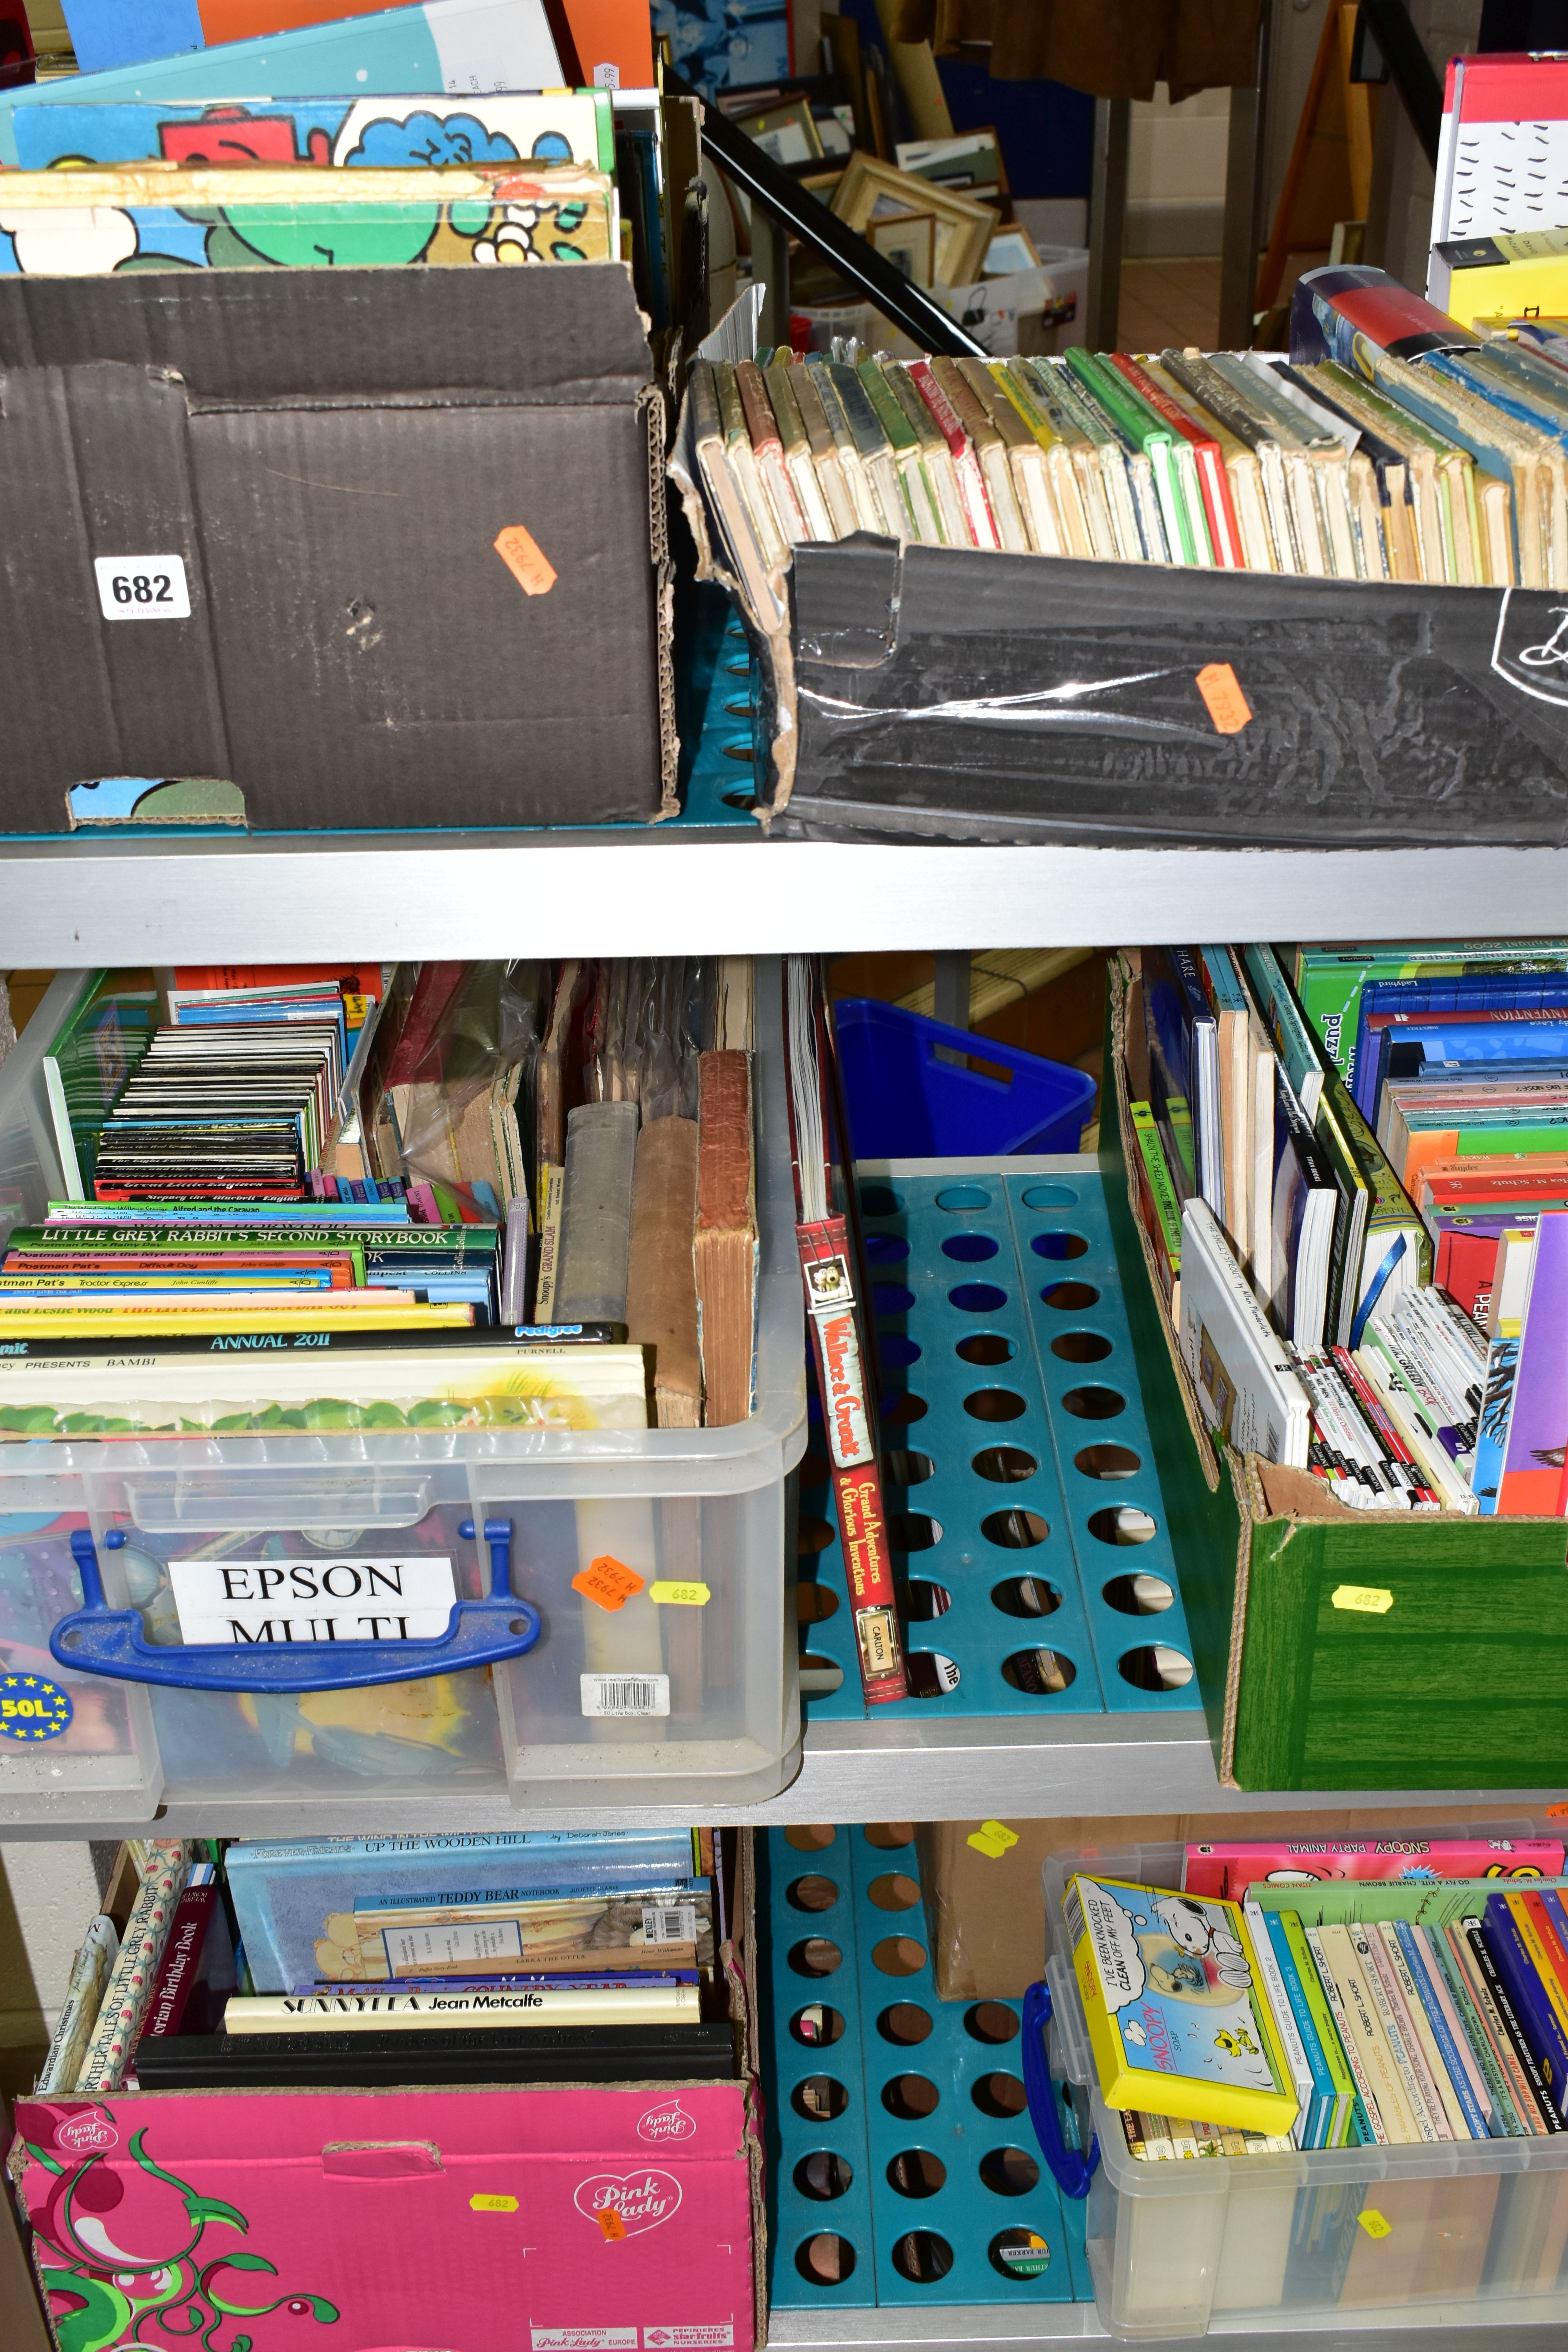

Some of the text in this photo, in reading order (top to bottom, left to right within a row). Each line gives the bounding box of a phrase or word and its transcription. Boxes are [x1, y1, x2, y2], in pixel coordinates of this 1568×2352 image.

[505, 537, 544, 586] H 7932
[113, 575, 174, 603] 682
[1203, 673, 1238, 730] H 7932
[1176, 949, 1196, 978] HARE
[1144, 1133, 1170, 1200] SHAUN THE SHEEP MOVIE:
[1306, 1156, 1321, 1182] TITAN BOOKS
[42, 1229, 451, 1245] LITTLE GREY RABBIT'S SECOND STORYBOOK
[1207, 1221, 1218, 1234] THE
[456, 1229, 467, 1250] Collins
[1212, 1234, 1229, 1256] SHELLY
[536, 1225, 556, 1305] Snoopy's GRAND SLAM
[1223, 1256, 1241, 1279] SPROUT
[113, 1279, 149, 1288] Express
[1241, 1290, 1252, 1305] Allan
[1249, 1306, 1271, 1338] Plenderleith
[211, 1334, 288, 1350] ANNUAL
[294, 1333, 330, 1347] 2011
[515, 1324, 583, 1338] Pedigree
[25, 1360, 91, 1368] PRESENTS
[107, 1358, 156, 1367] BAMBI
[823, 1314, 861, 1458] Wallace & Gromit
[1336, 1452, 1352, 1474] EGMONT
[1382, 1462, 1399, 1485] EGMONT
[1365, 1467, 1382, 1490] EGMONT
[840, 1477, 866, 1596] & Glorious Inventions
[859, 1482, 881, 1584] Grand Adventures
[216, 1565, 405, 1600] EPSON
[597, 1563, 636, 1591] H 7932
[588, 1577, 628, 1603] H 7932
[672, 1589, 697, 1600] 682
[1354, 1593, 1380, 1607] 682
[872, 1626, 884, 1661] CARLTON
[1, 1699, 53, 1719] 50L
[365, 1834, 532, 1853] UP THE WOODEN HILL
[550, 1833, 561, 1842] by
[994, 1829, 1011, 1843] 682
[1285, 1840, 1430, 1855] SNOOPY PARTY ANIMAL
[390, 1896, 436, 1905] ILLUSTRATED
[438, 1891, 482, 1905] TEDDY
[485, 1889, 519, 1902] BEAR
[521, 1888, 560, 1896] NOTEBOOK
[1088, 1899, 1118, 1987] I'VE BEEN KNOCKED
[1099, 1900, 1131, 1991] CLEAN OFF MY FEET
[97, 1886, 159, 2052] TALES OF LITTLE GREY RABBIT
[150, 1922, 198, 2036] orian Birthday Book
[1268, 1963, 1278, 1981] BOOK
[1273, 1983, 1283, 1998] LIFE
[1287, 1973, 1299, 1992] BOOK
[281, 1994, 543, 2014] SUNNYLEA Jean Metcalfe
[1278, 1998, 1286, 2008] TO
[1293, 1993, 1304, 2008] LIFE
[1281, 2010, 1293, 2031] GUIDE
[1298, 2008, 1307, 2018] TO
[1140, 2001, 1174, 2071] SNOOPY
[1170, 2031, 1181, 2051] SOAP
[1302, 2019, 1314, 2041] GUIDE
[39, 1999, 74, 2091] Edwardian Christmas
[1288, 2032, 1303, 2065] PEANUTS
[1309, 2042, 1325, 2076] PEANUTS
[1335, 2011, 1382, 2131] GOSPEL ACCORDING TO PEANUTS
[1540, 2090, 1562, 2130] PEANUTS
[1354, 2102, 1371, 2142] PEANUTS
[488, 2199, 509, 2208] 682
[592, 2176, 666, 2221] Pink Lady
[1368, 2220, 1384, 2234] 682
[536, 2338, 569, 2348] Pink
[572, 2337, 600, 2347] Lady
